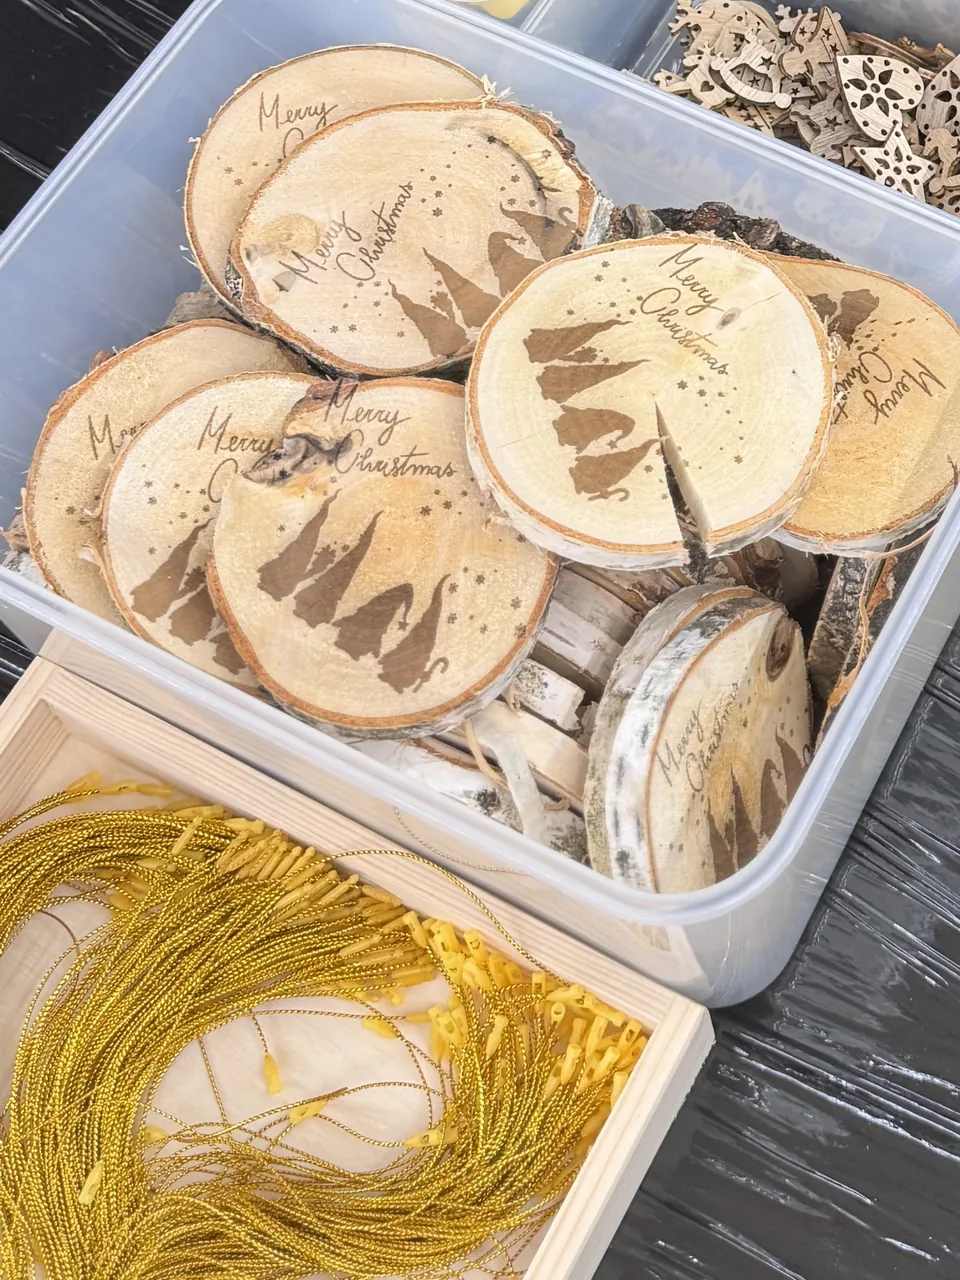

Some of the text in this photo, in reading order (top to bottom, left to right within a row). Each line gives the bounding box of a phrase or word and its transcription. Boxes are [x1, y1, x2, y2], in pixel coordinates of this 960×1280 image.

[259, 91, 339, 132] Merry
[278, 210, 363, 285] Merry
[335, 181, 414, 282] Christmas
[658, 242, 725, 316] Merry
[639, 287, 730, 376] Christmas
[324, 377, 412, 447] Merry
[862, 357, 947, 426] Merry
[334, 428, 458, 478] Christmas
[656, 699, 705, 788] Merry
